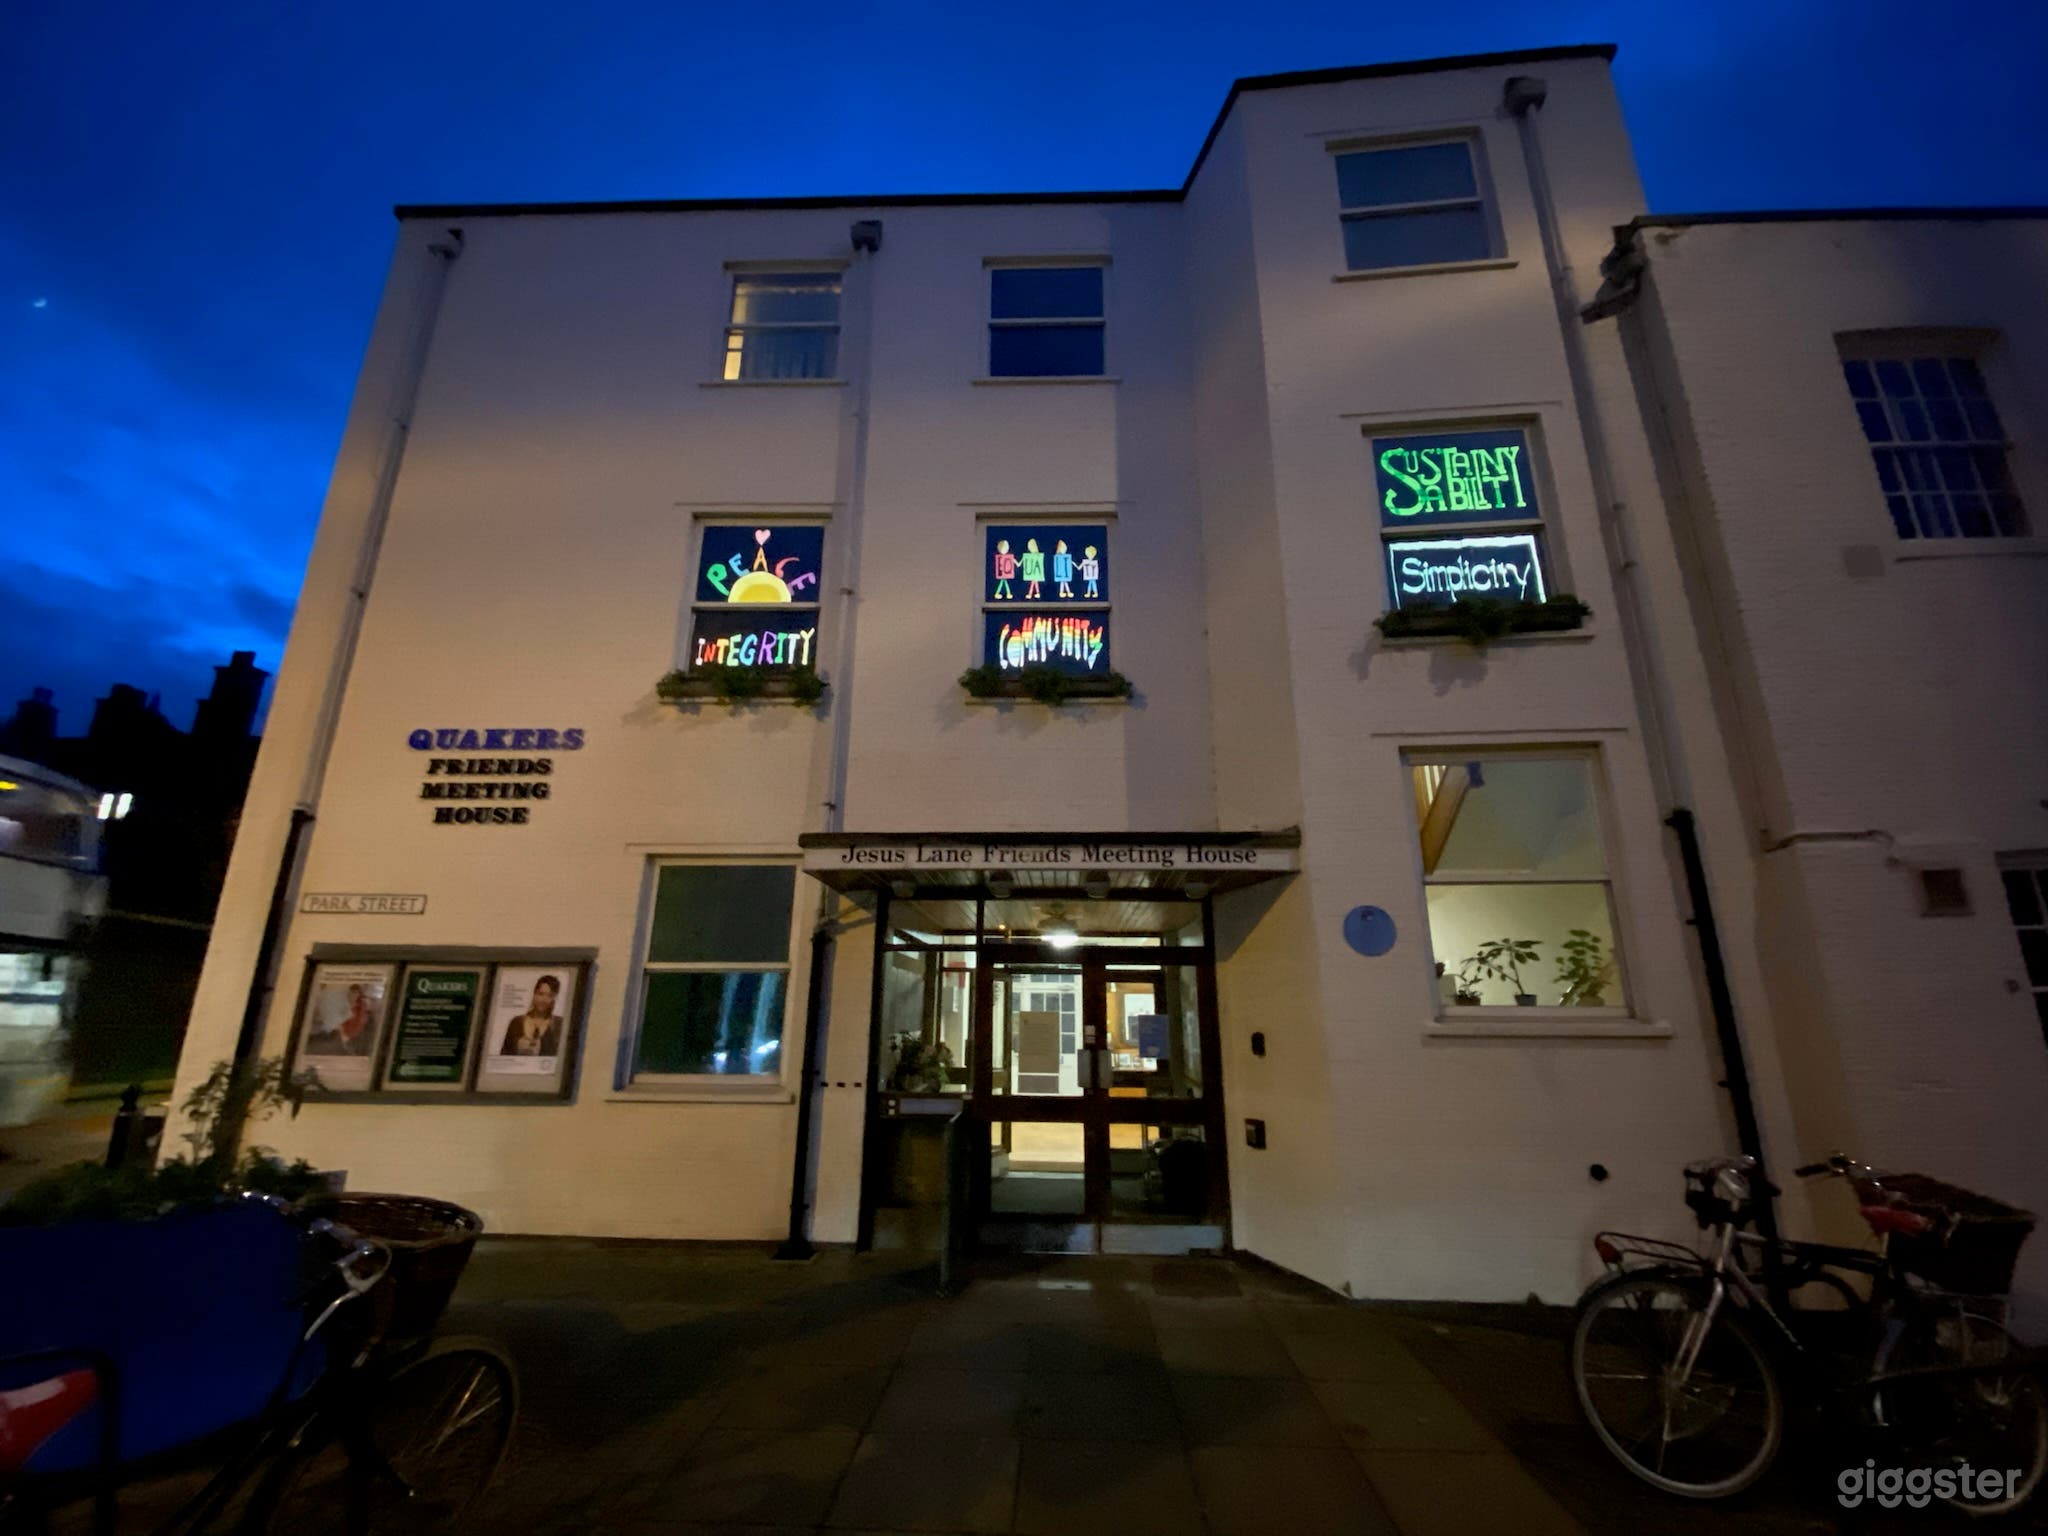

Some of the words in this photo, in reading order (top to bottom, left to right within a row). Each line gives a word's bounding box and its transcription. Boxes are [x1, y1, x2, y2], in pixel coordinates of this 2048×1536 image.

[695, 627, 815, 666] INTEGRITY
[408, 728, 585, 750] QUAKERS
[426, 758, 552, 775] FRIENDS
[420, 782, 551, 799] MEETING
[433, 807, 530, 824] HOUSE
[842, 844, 905, 864] Jesus
[915, 844, 972, 864] Lane
[983, 844, 1071, 864] Friends
[1082, 844, 1174, 867] Meeting
[1186, 844, 1257, 864] House
[310, 896, 351, 910] PARK
[358, 896, 419, 911] STREET
